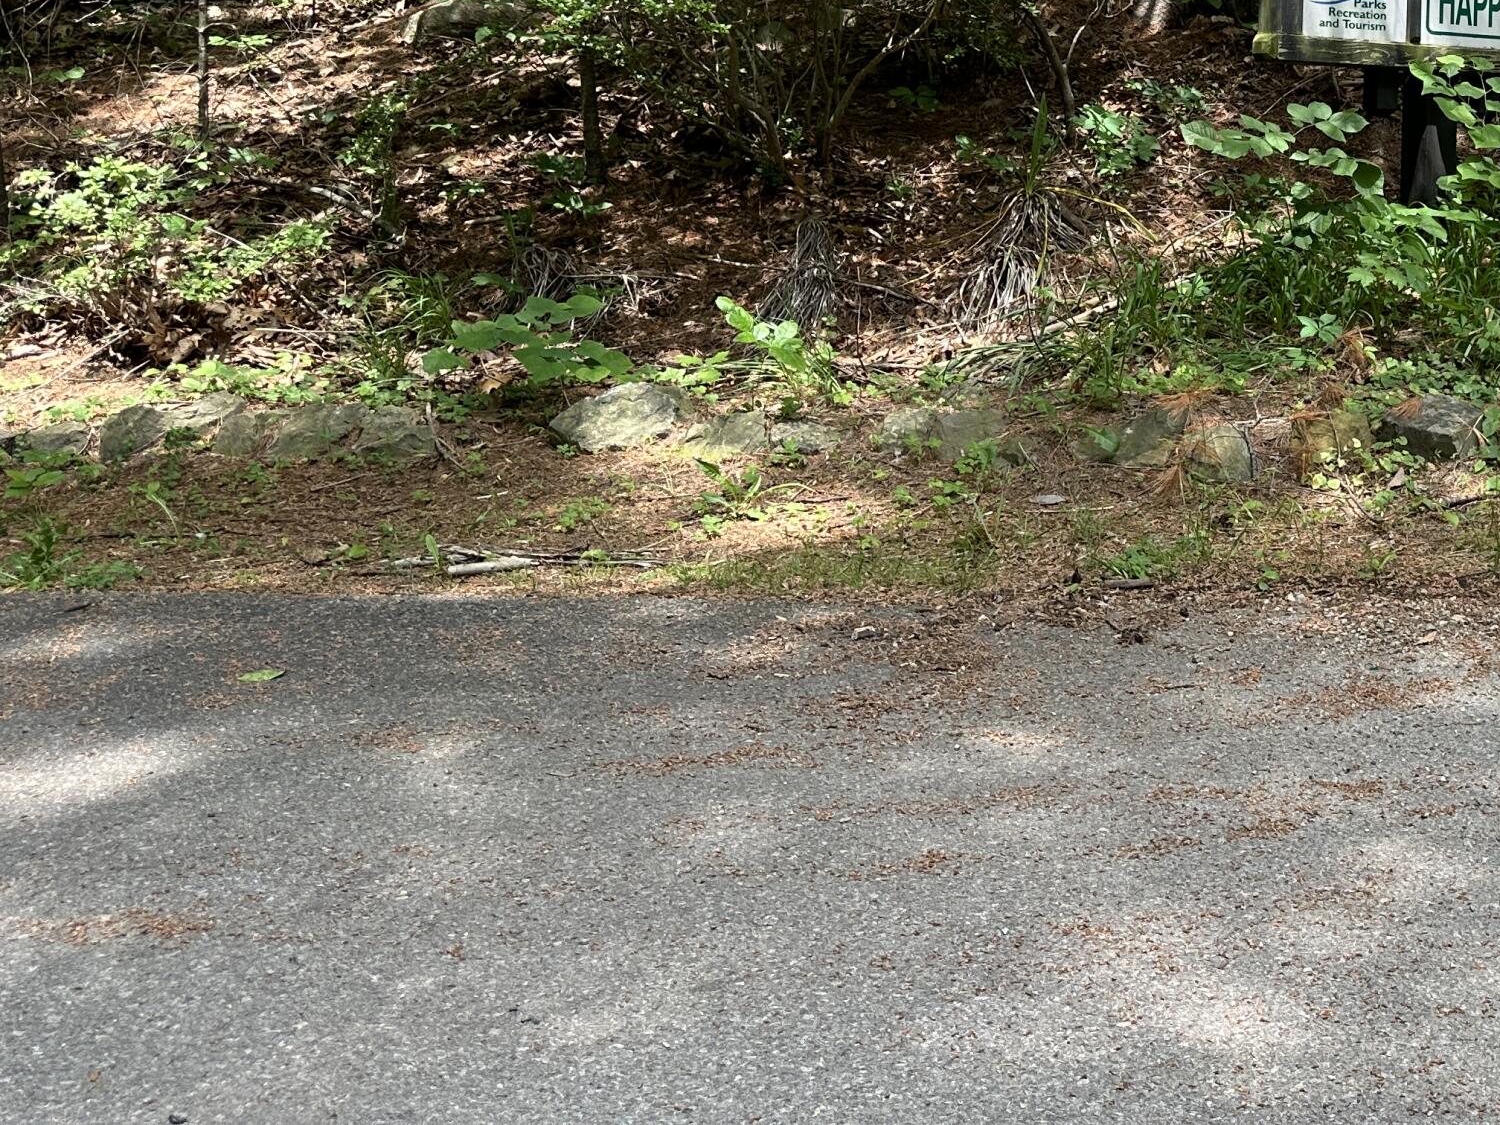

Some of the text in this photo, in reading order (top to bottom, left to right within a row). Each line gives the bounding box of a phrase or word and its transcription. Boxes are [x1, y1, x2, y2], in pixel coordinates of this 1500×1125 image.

[1328, 7, 1387, 20] Recreation
[1318, 19, 1387, 31] and Tourism
